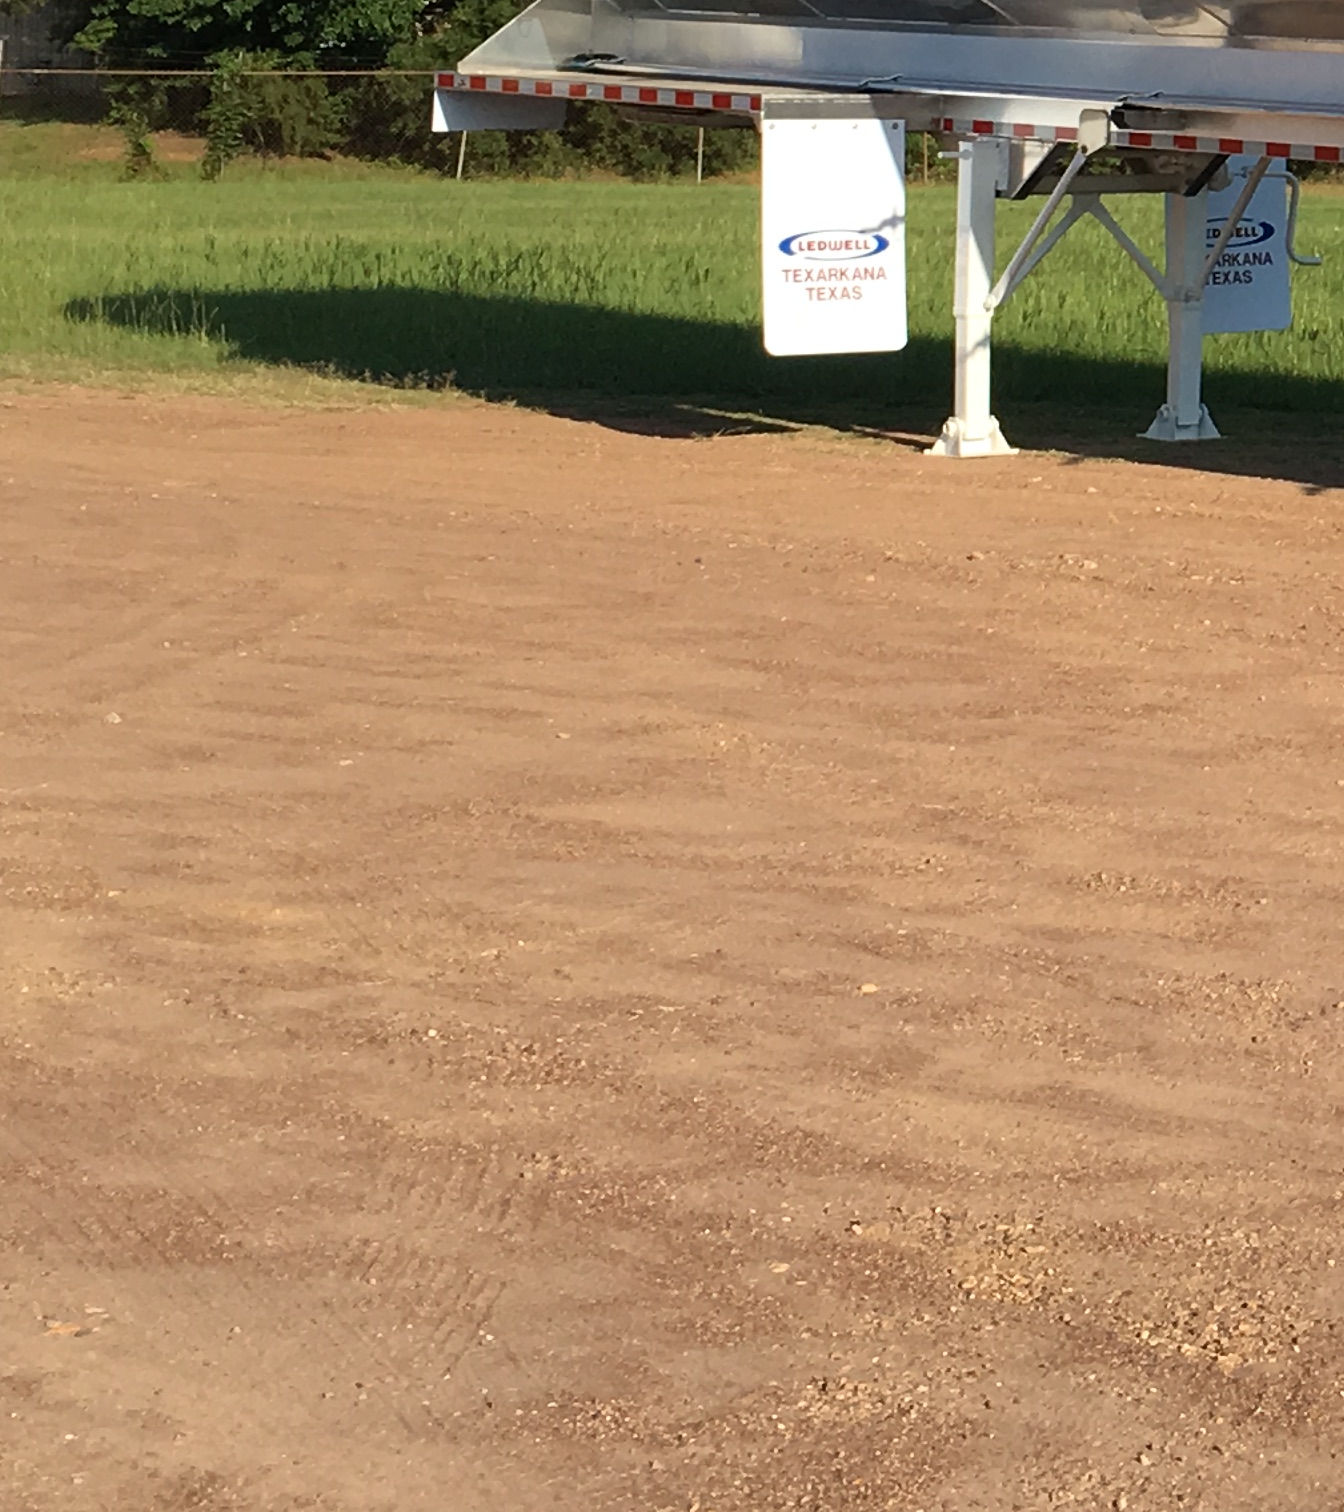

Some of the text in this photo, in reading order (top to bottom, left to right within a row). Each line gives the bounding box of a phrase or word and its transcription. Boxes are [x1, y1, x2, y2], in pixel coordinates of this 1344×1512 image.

[798, 239, 871, 252] LEDWELL
[781, 266, 888, 283] TEXARKANA
[1205, 269, 1253, 286] EXAS
[805, 285, 863, 301] TEXAS
